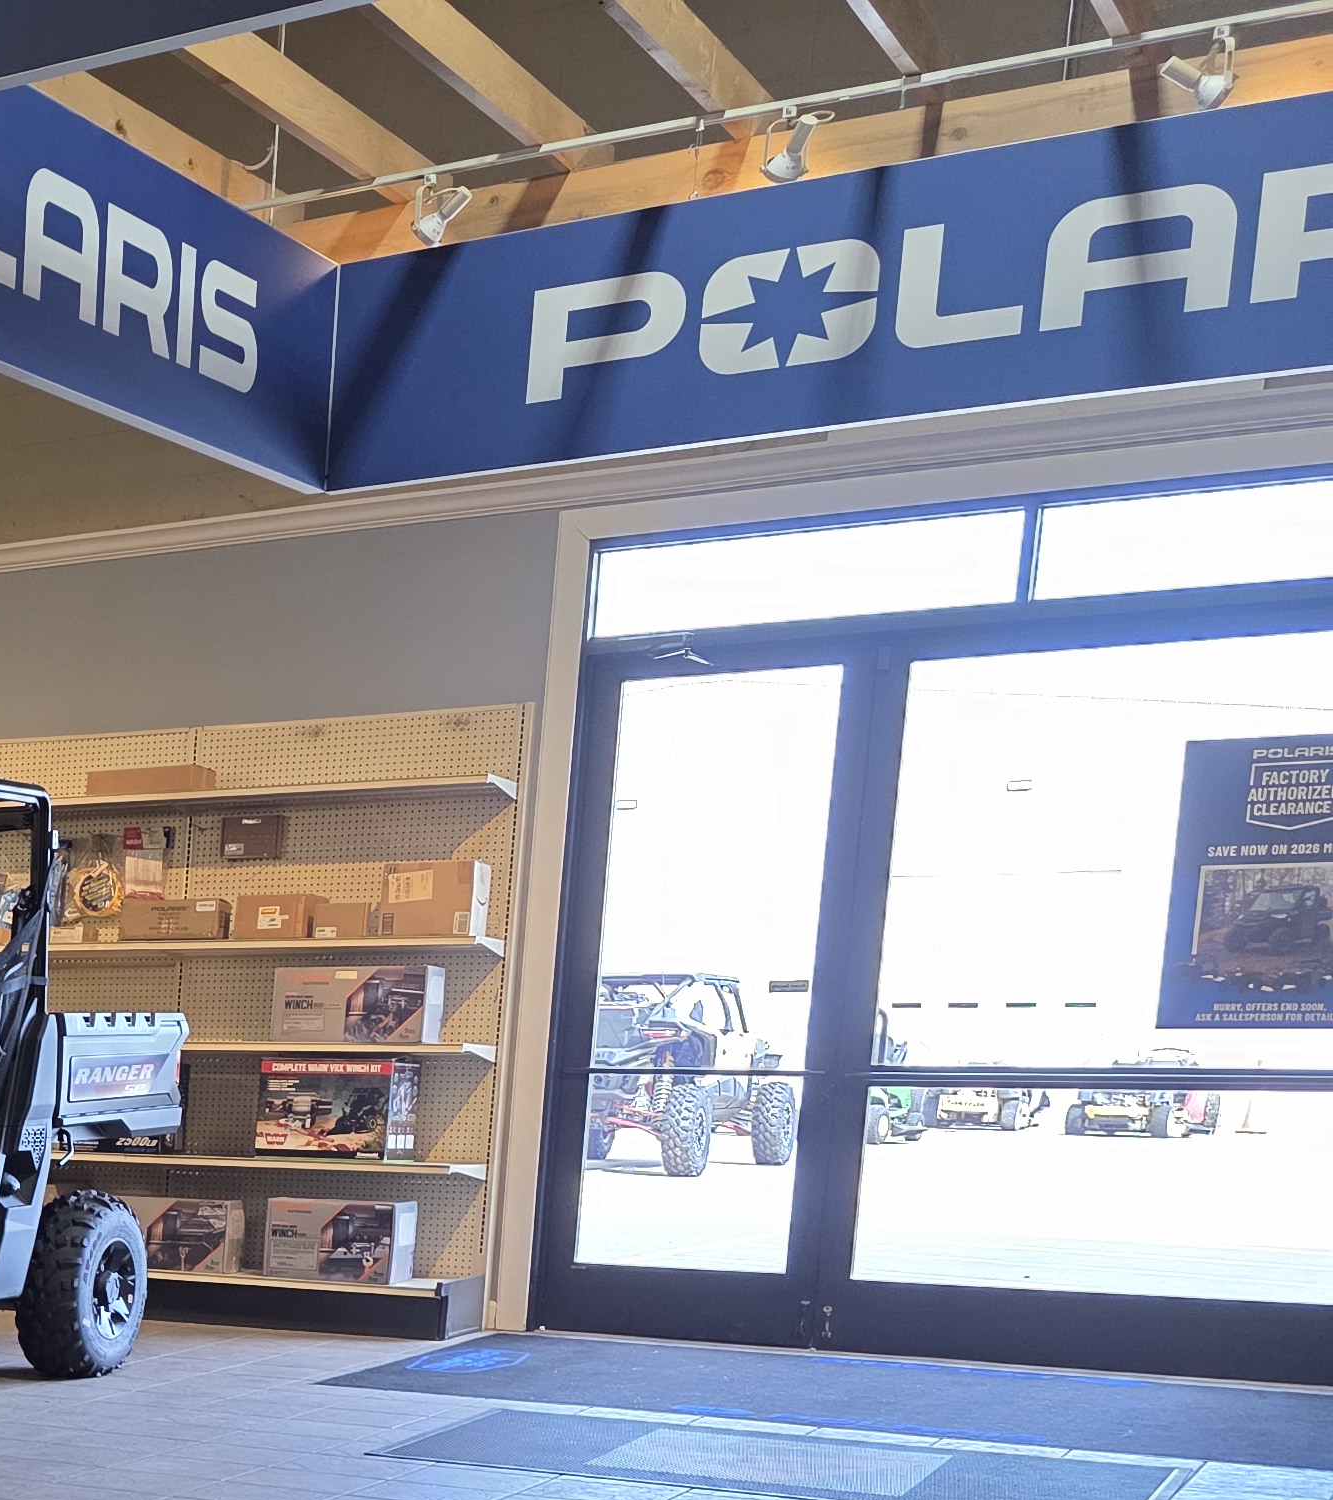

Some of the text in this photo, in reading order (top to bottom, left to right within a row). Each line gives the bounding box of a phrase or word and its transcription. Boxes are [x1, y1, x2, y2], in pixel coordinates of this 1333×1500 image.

[1262, 769, 1330, 786] FACTORY
[1247, 785, 1333, 802] AUTHORIZE
[1253, 801, 1332, 816] CLEARANCE
[1207, 845, 1237, 857] SAVE
[1240, 844, 1268, 856] NOW
[1271, 844, 1287, 855] ON
[1290, 843, 1320, 855] 2026
[285, 1000, 313, 1010] WINCH
[1213, 1003, 1327, 1012] HURRY, OFFERS END SOON.
[1195, 1013, 1212, 1021] ASK
[1213, 1013, 1221, 1021] A
[1222, 1013, 1283, 1021] SALESPERSON
[1285, 1013, 1302, 1021] FOR
[272, 1063, 306, 1072] COMPLETE
[346, 1063, 369, 1072] WINCH
[74, 1064, 154, 1085] RANGER
[123, 1084, 147, 1094] SP
[271, 1228, 297, 1238] WINCH
